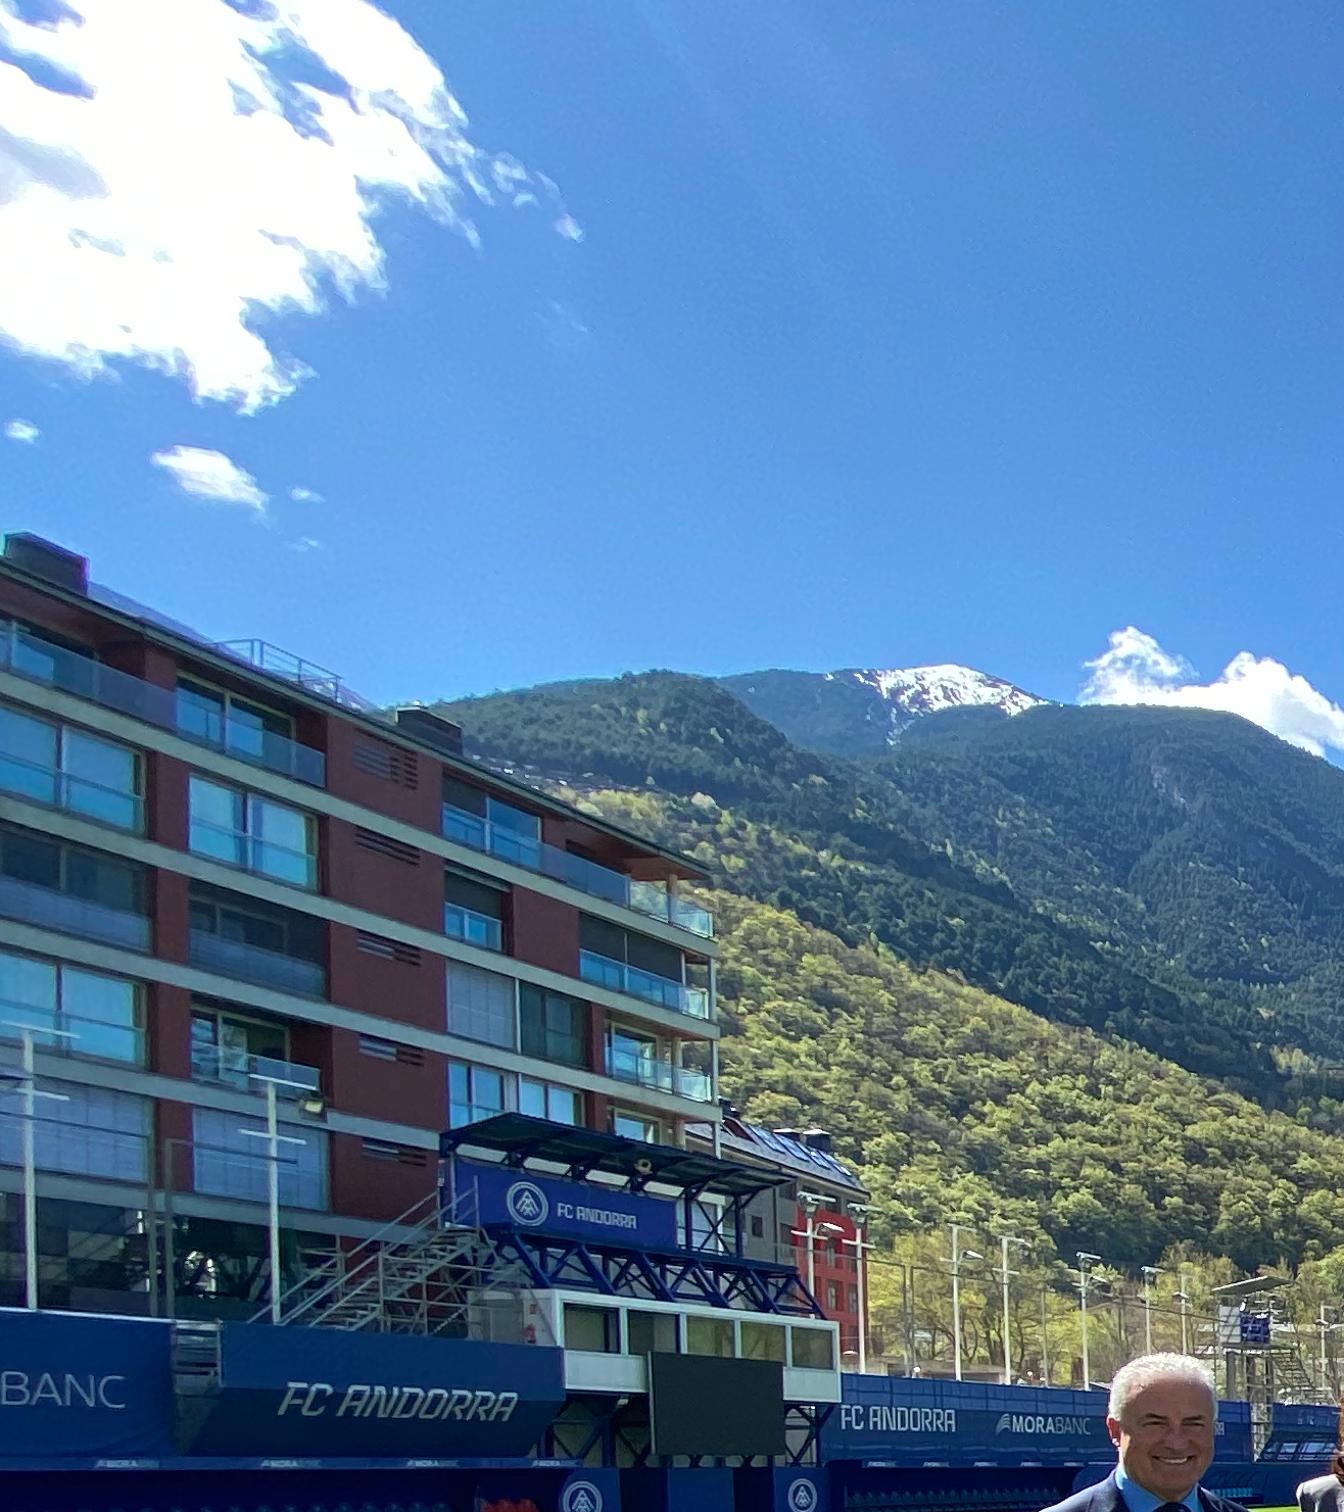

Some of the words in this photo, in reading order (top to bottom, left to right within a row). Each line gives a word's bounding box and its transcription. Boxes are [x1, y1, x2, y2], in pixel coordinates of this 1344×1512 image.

[557, 1203, 574, 1219] FC
[576, 1206, 638, 1229] ANDORRA
[0, 1370, 126, 1409] BANC
[277, 1381, 334, 1417] FC
[336, 1384, 519, 1422] ANDORRA
[840, 1404, 865, 1431] FC
[869, 1406, 956, 1433] ANDORRA
[1011, 1414, 1092, 1436] MORABANC
